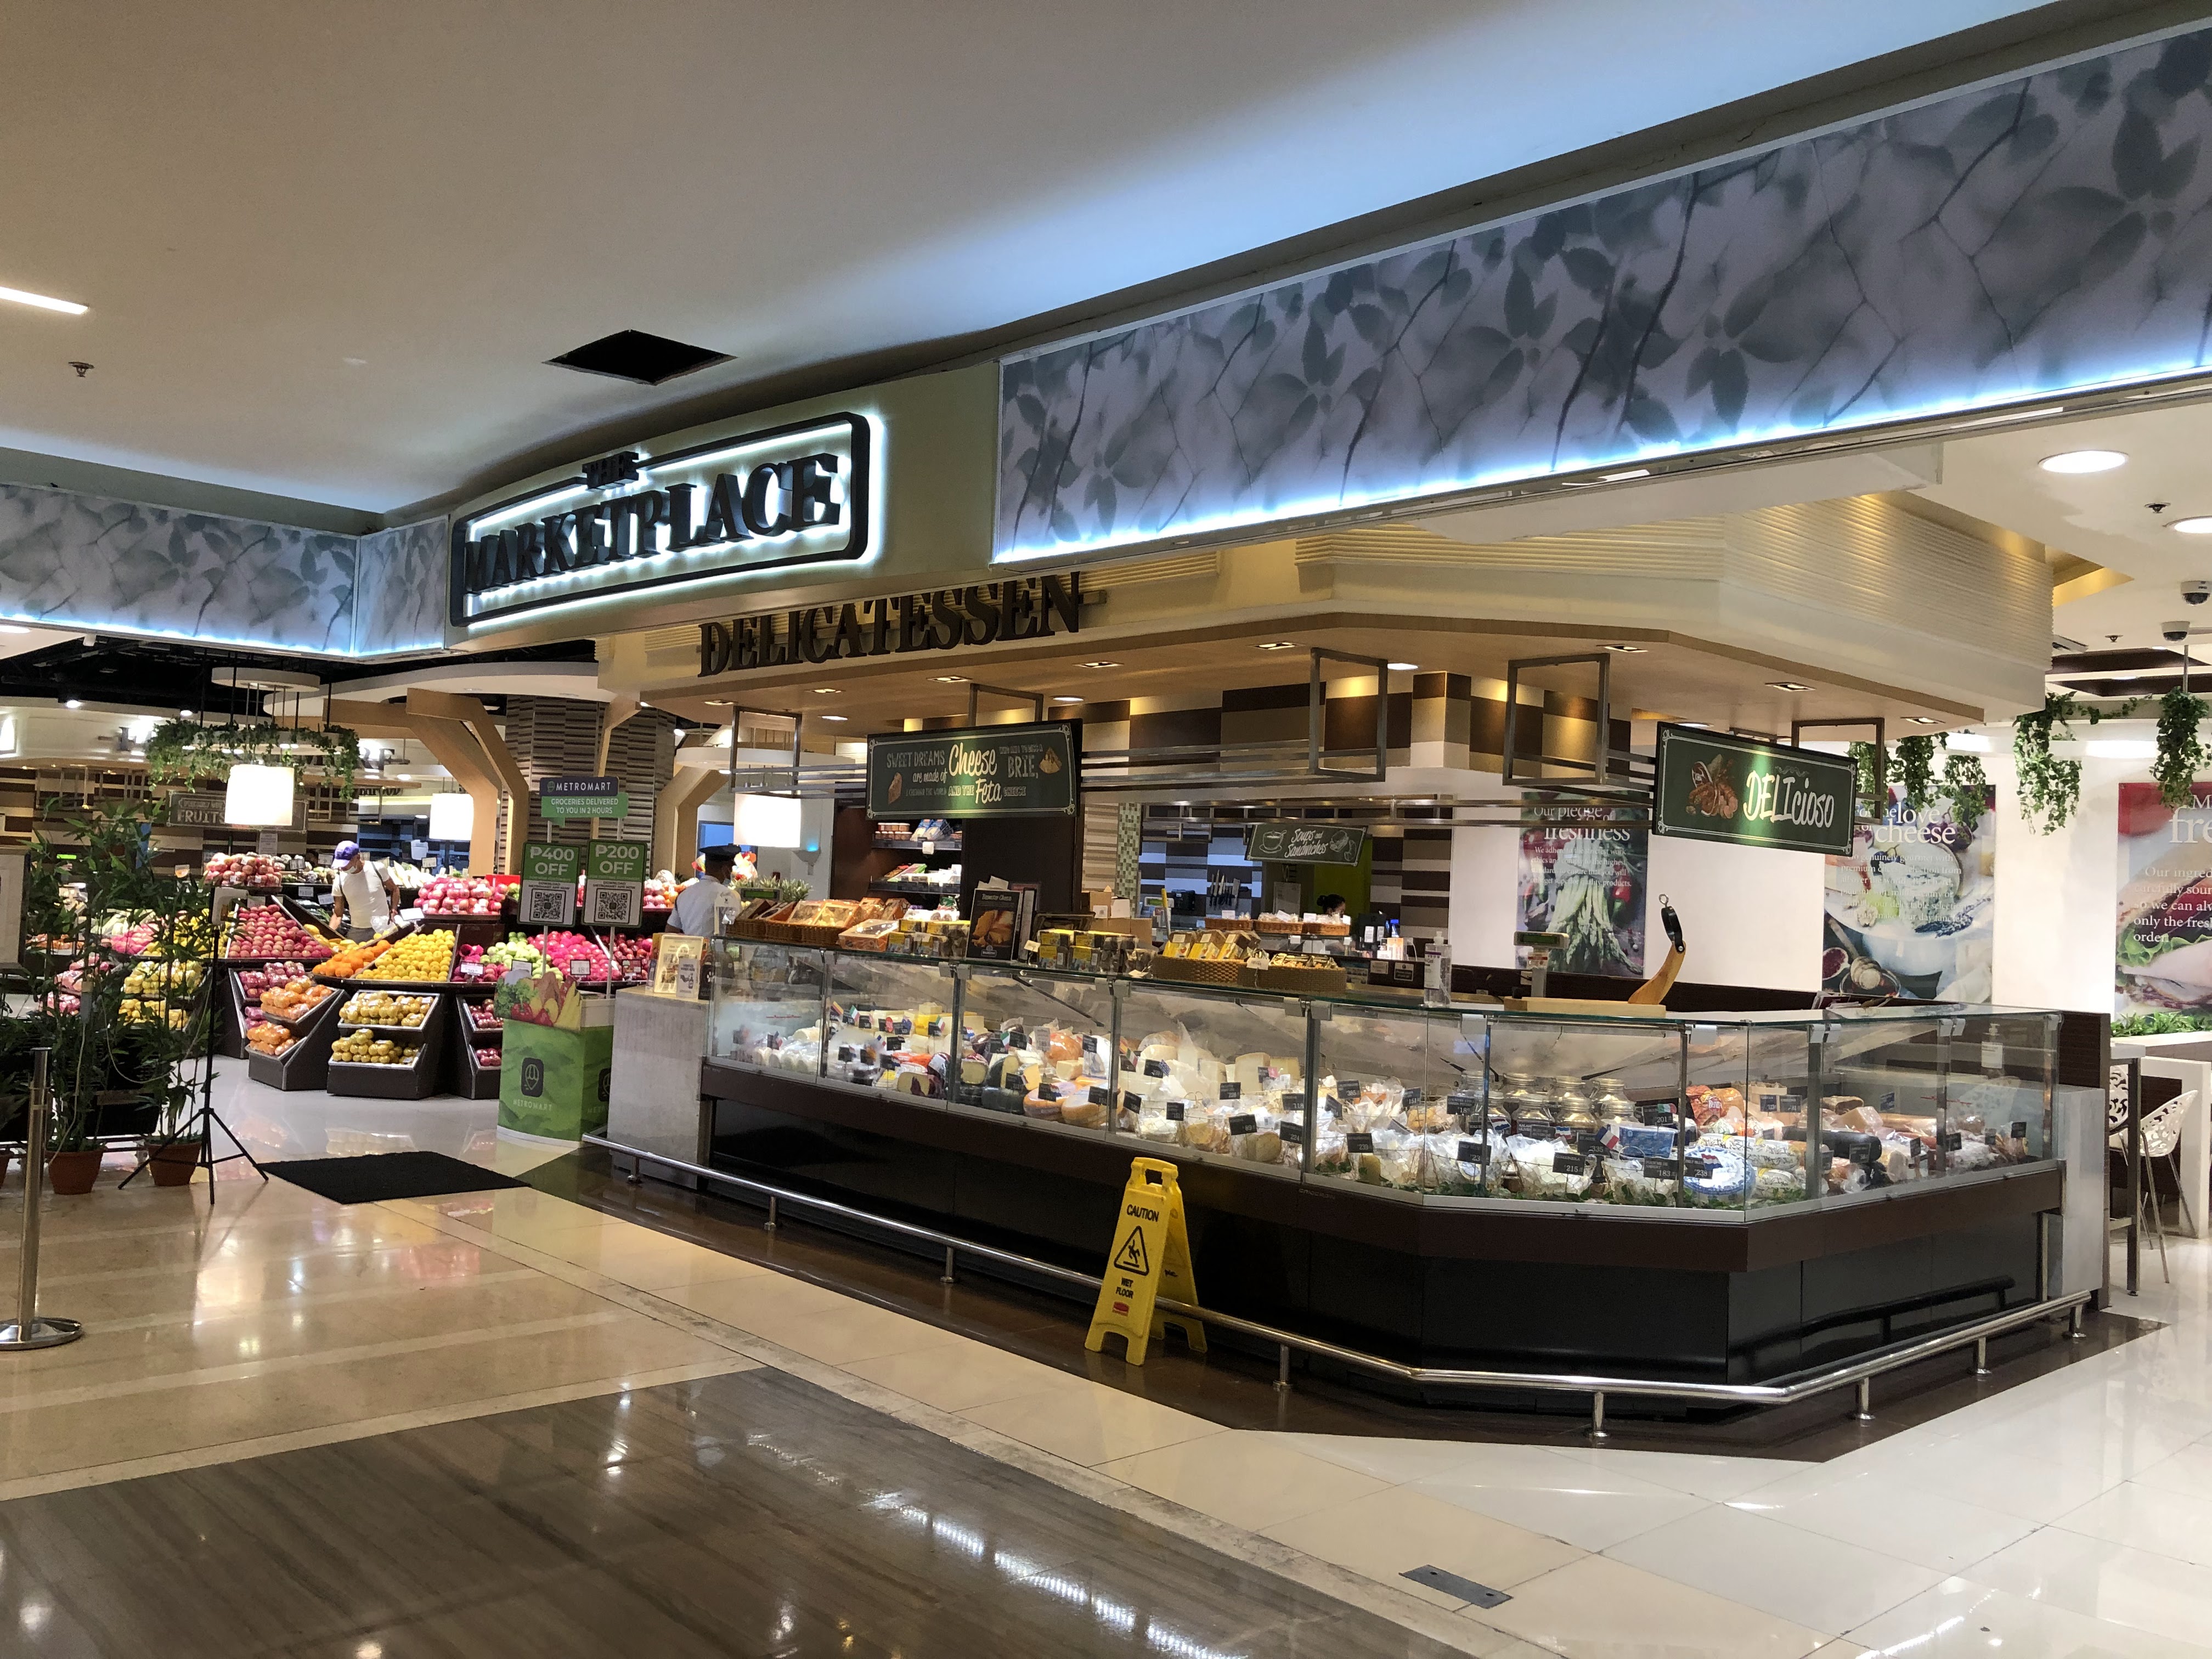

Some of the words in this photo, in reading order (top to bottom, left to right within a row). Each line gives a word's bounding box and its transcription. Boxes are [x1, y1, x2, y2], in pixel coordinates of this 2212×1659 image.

[582, 451, 639, 489] THE
[465, 453, 840, 593] MARKETPLACE
[698, 571, 1080, 677] DELICATESSEN
[887, 752, 912, 768] SWEET
[914, 750, 945, 767] DREAMS
[949, 742, 997, 777] Cheese
[912, 772, 922, 783] are
[923, 769, 939, 782] made
[940, 768, 947, 783] of
[556, 782, 611, 791] METROMART
[948, 785, 961, 796] AND
[962, 785, 974, 795] THE
[975, 778, 1002, 804] Feta
[1003, 786, 1026, 797] CHEESE
[1897, 802, 1940, 823] love
[1291, 828, 1316, 844] Soups
[1875, 818, 1956, 844] cheese
[1284, 840, 1329, 858] Sandwiches
[535, 862, 568, 875] OFF
[600, 861, 634, 874] OFF
[2145, 867, 2170, 877] Our
[1602, 879, 1632, 888] products.
[2171, 902, 2192, 911] can
[2134, 916, 2160, 929] only
[2164, 916, 2183, 927] the
[513, 1099, 552, 1111] METROMART
[1126, 1204, 1160, 1222] CAUTION
[1121, 1276, 1134, 1288] WET
[1115, 1286, 1134, 1299] FLOOR
